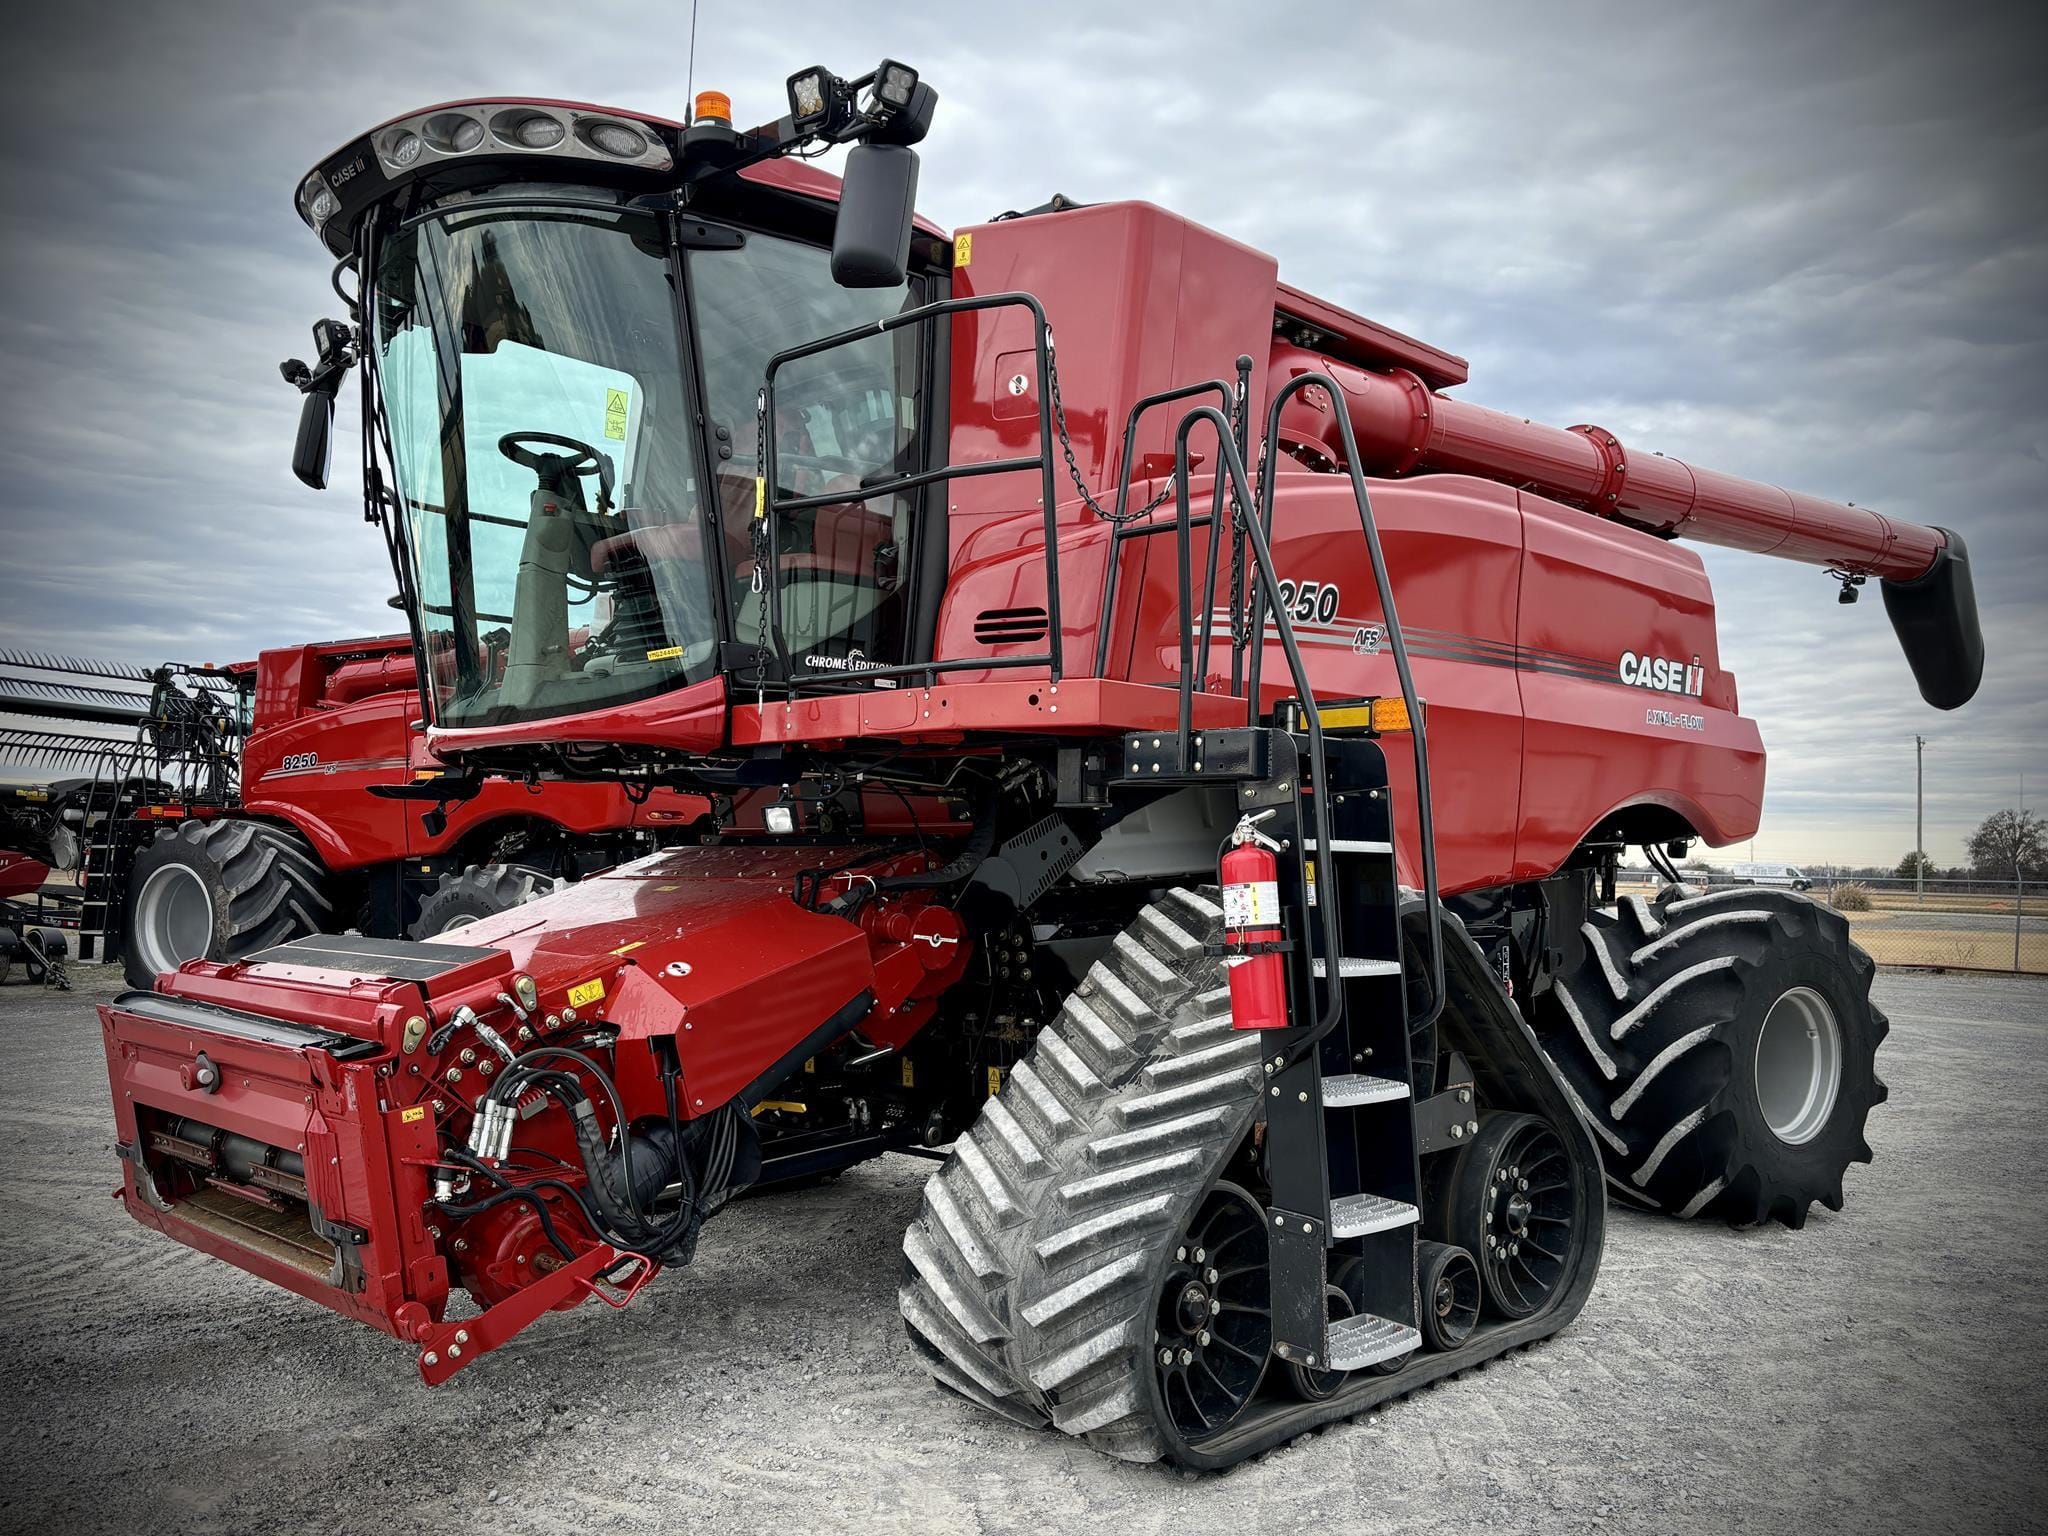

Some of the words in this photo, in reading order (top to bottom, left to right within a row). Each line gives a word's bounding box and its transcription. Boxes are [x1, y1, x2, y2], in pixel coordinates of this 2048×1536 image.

[331, 164, 357, 187] CASE
[1265, 579, 1340, 625] 250
[1353, 628, 1380, 646] AFS
[805, 655, 847, 670] CHROME
[1619, 651, 1684, 693] CASE
[1646, 709, 1704, 731] AXIAL-FLOW
[283, 752, 318, 770] 8250
